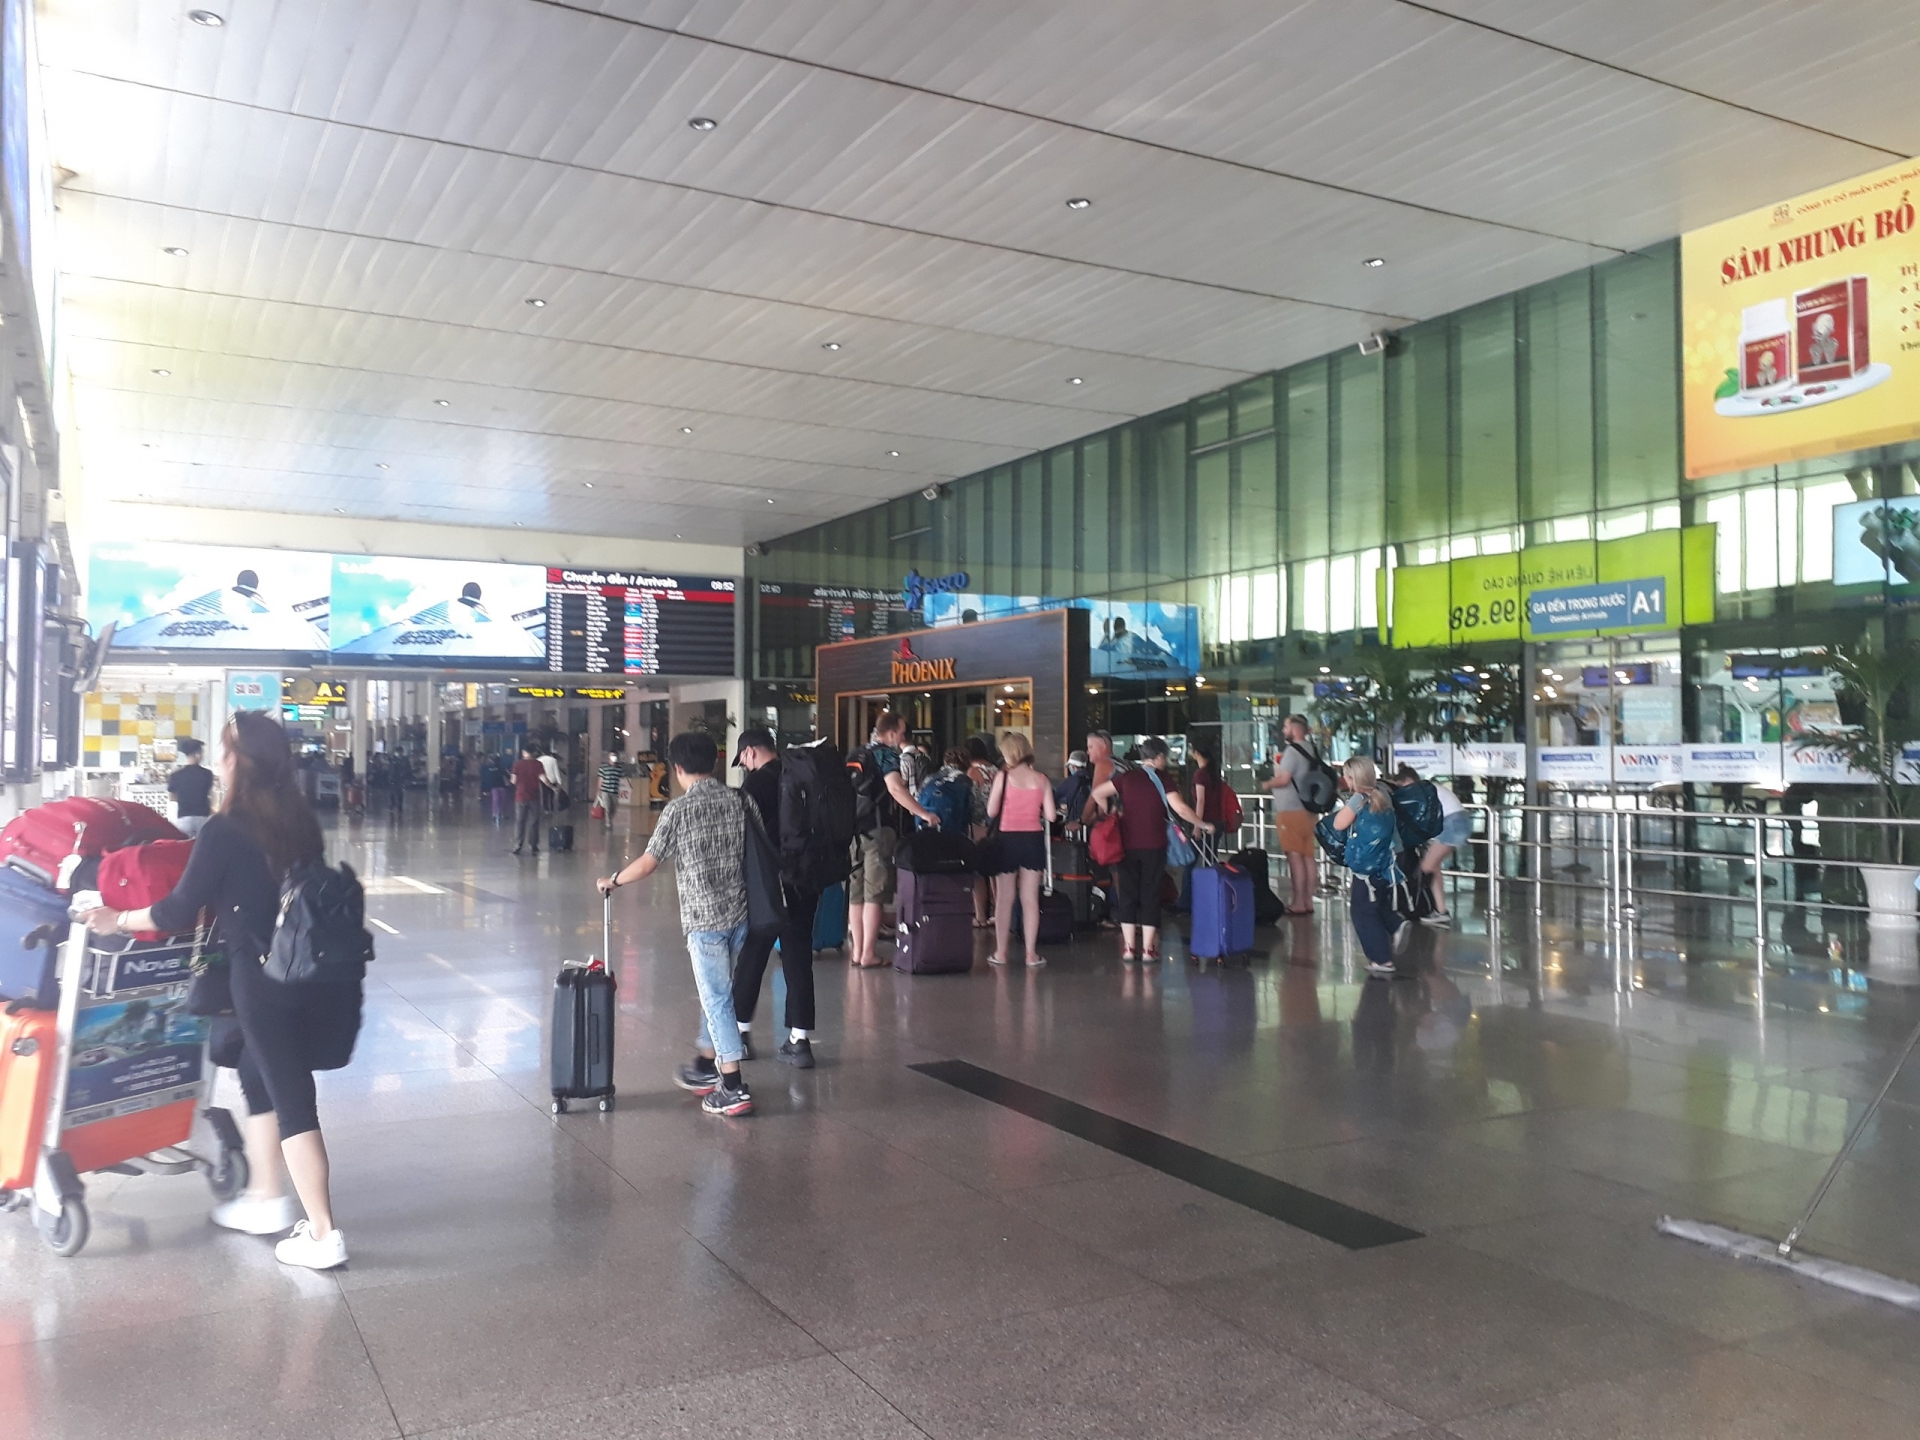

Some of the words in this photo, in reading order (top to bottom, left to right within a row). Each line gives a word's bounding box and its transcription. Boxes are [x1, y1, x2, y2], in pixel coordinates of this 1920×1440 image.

[1777, 216, 1866, 268] NHUNG
[1874, 189, 1916, 240] BỔ
[636, 575, 678, 588] Arrivals
[1533, 602, 1546, 614] GA
[1567, 596, 1598, 610] TRONG
[1632, 589, 1660, 615] A1
[891, 657, 955, 684] PHOENIX
